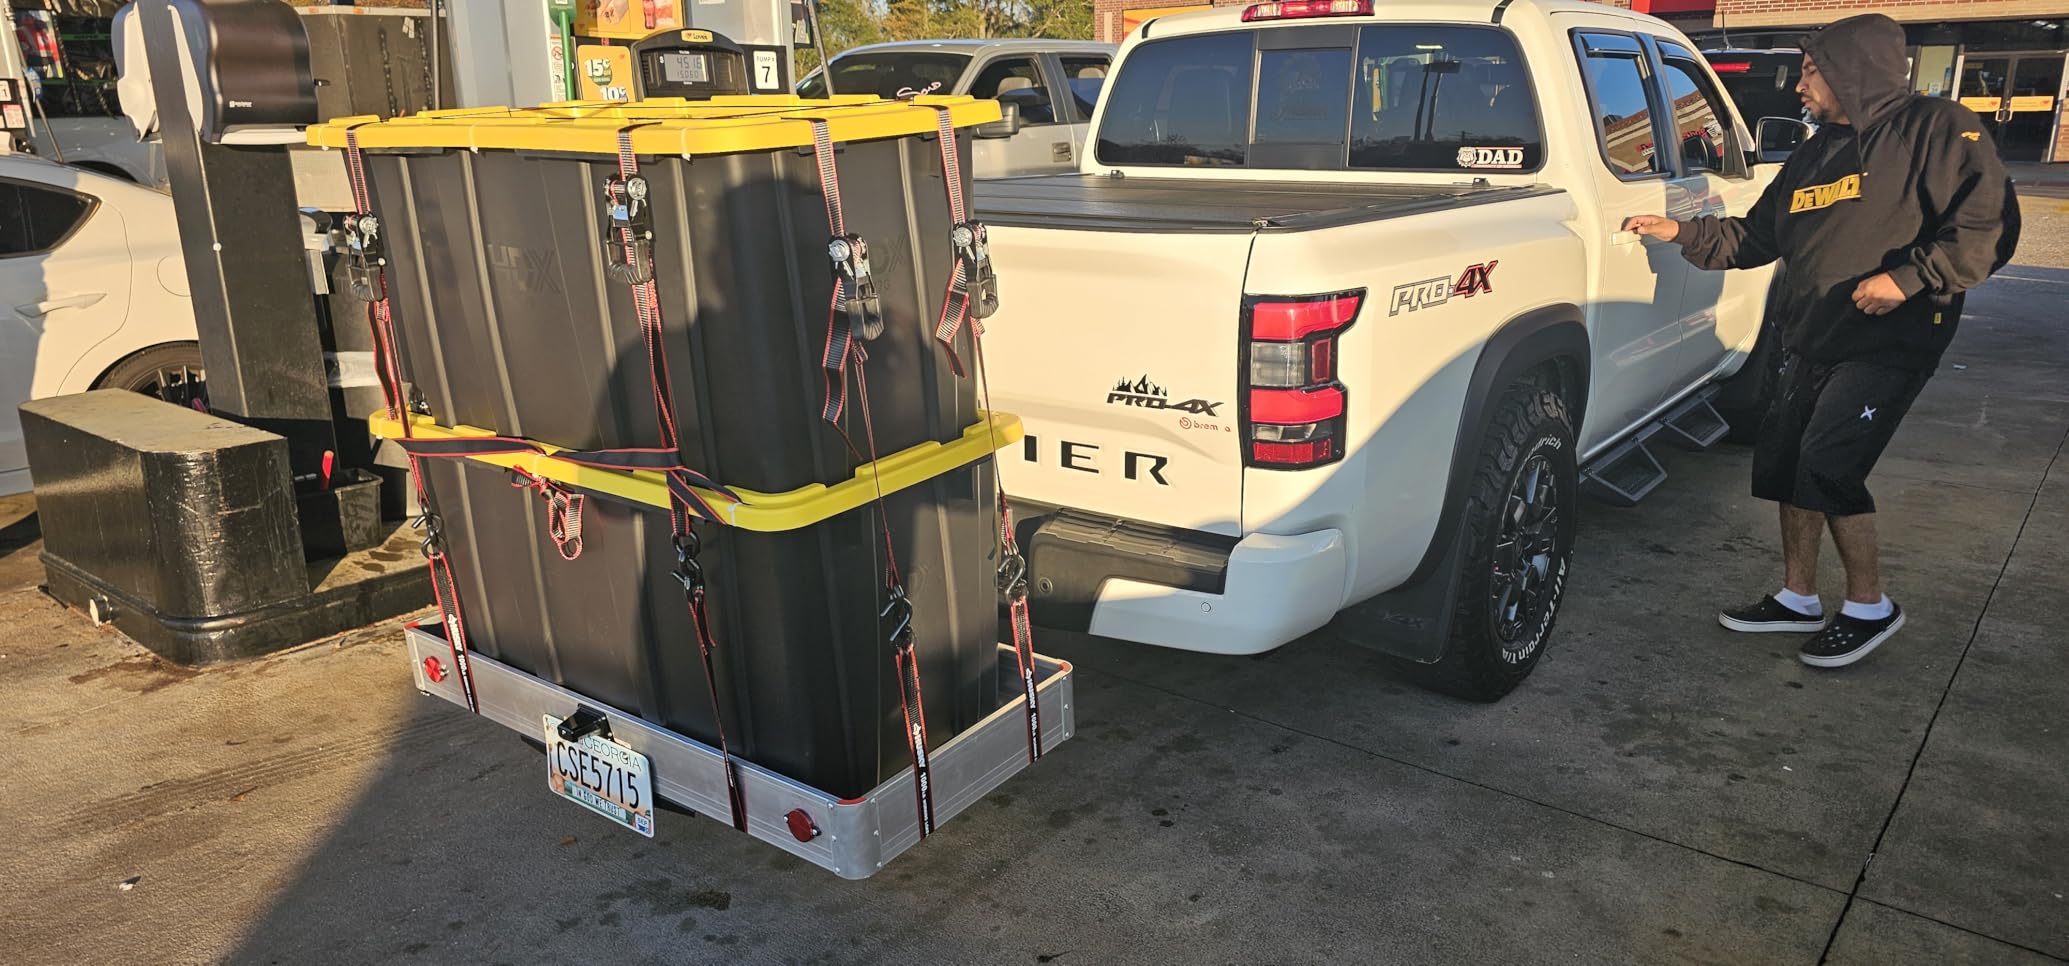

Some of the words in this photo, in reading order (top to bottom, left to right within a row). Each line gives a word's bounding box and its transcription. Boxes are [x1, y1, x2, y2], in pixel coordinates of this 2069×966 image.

[761, 65, 771, 83] 7
[1476, 149, 1524, 165] DAD
[1389, 259, 1499, 317] PRO-4X
[1106, 391, 1225, 417] PRO-4X
[582, 736, 642, 771] GEORGIA
[914, 733, 926, 768] HUSKY
[557, 741, 640, 809] CSE5715
[604, 800, 621, 817] TRUST
